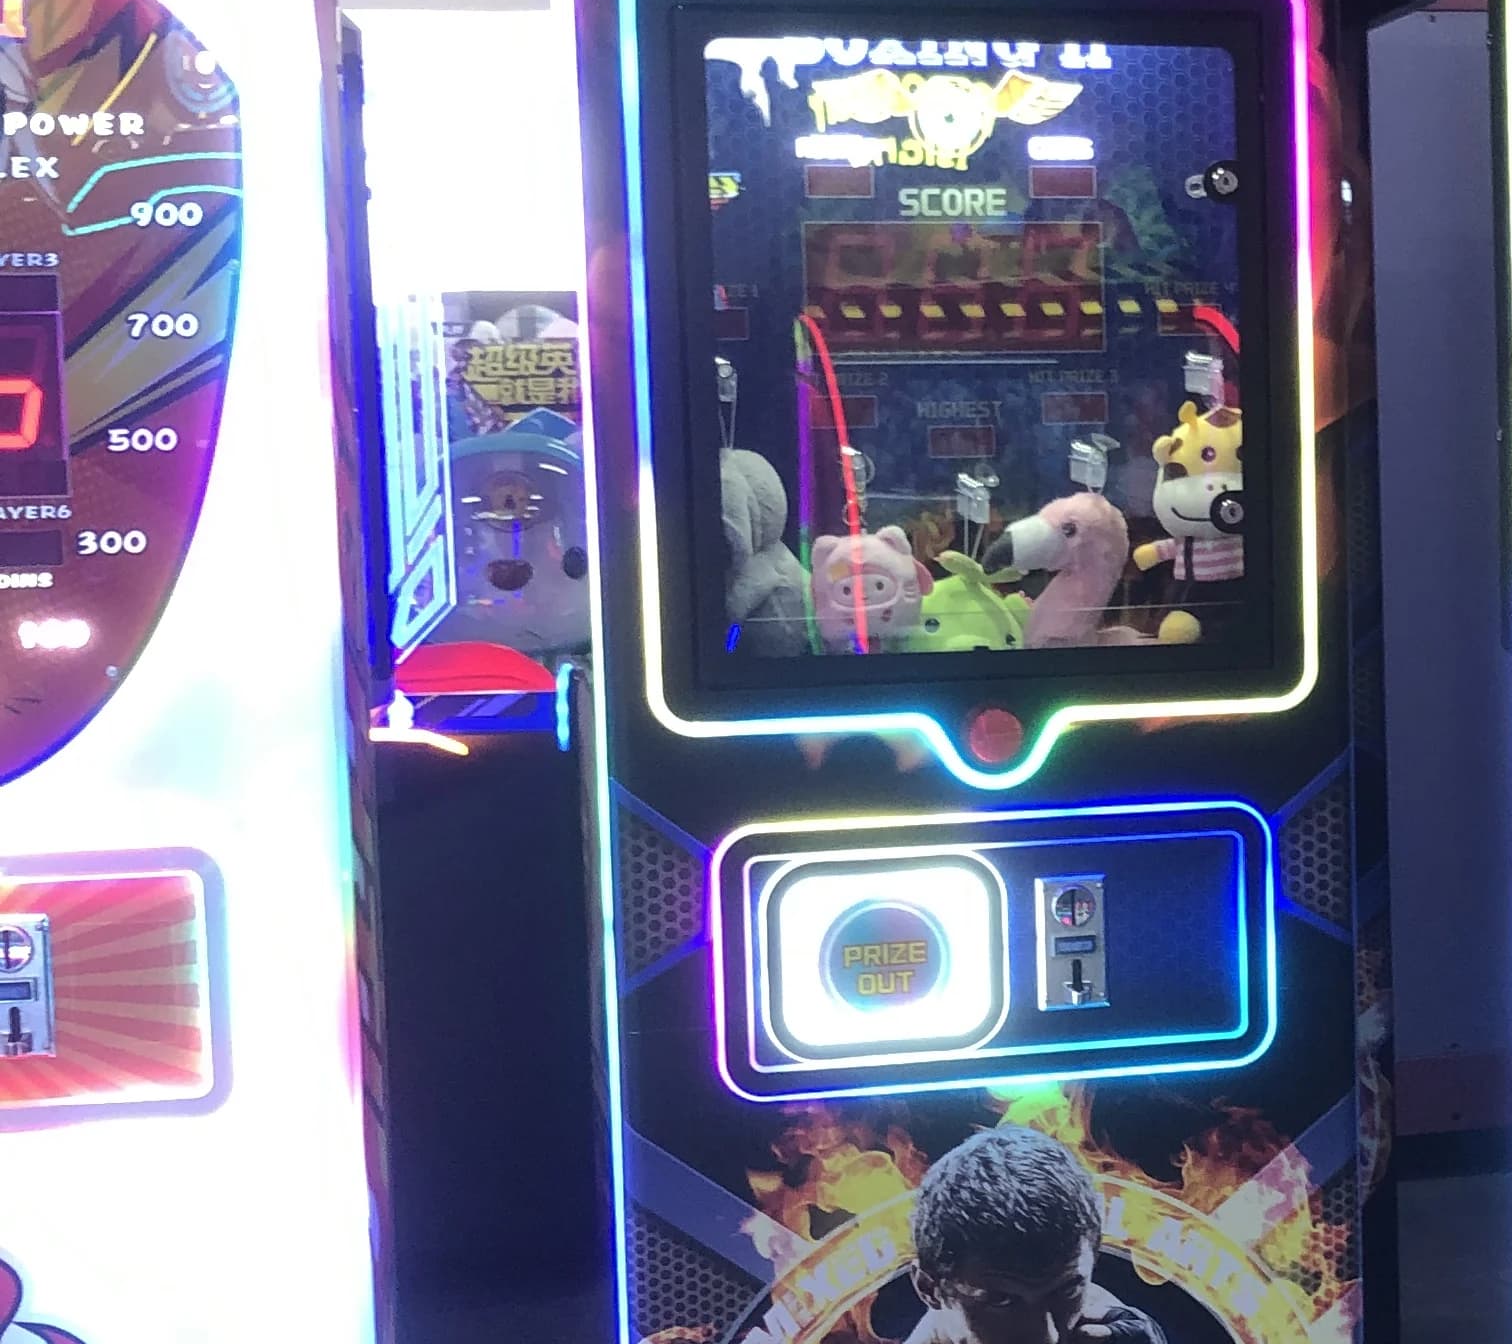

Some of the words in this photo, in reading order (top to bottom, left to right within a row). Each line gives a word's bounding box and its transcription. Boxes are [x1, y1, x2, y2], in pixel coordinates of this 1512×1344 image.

[3, 111, 145, 136] POWER
[130, 201, 204, 227] 900
[899, 187, 1007, 217] SCORE
[127, 313, 199, 338] 700
[107, 428, 178, 452] 500
[77, 530, 147, 554] 300
[841, 941, 928, 967] PRIZE
[857, 969, 914, 994] OUT
